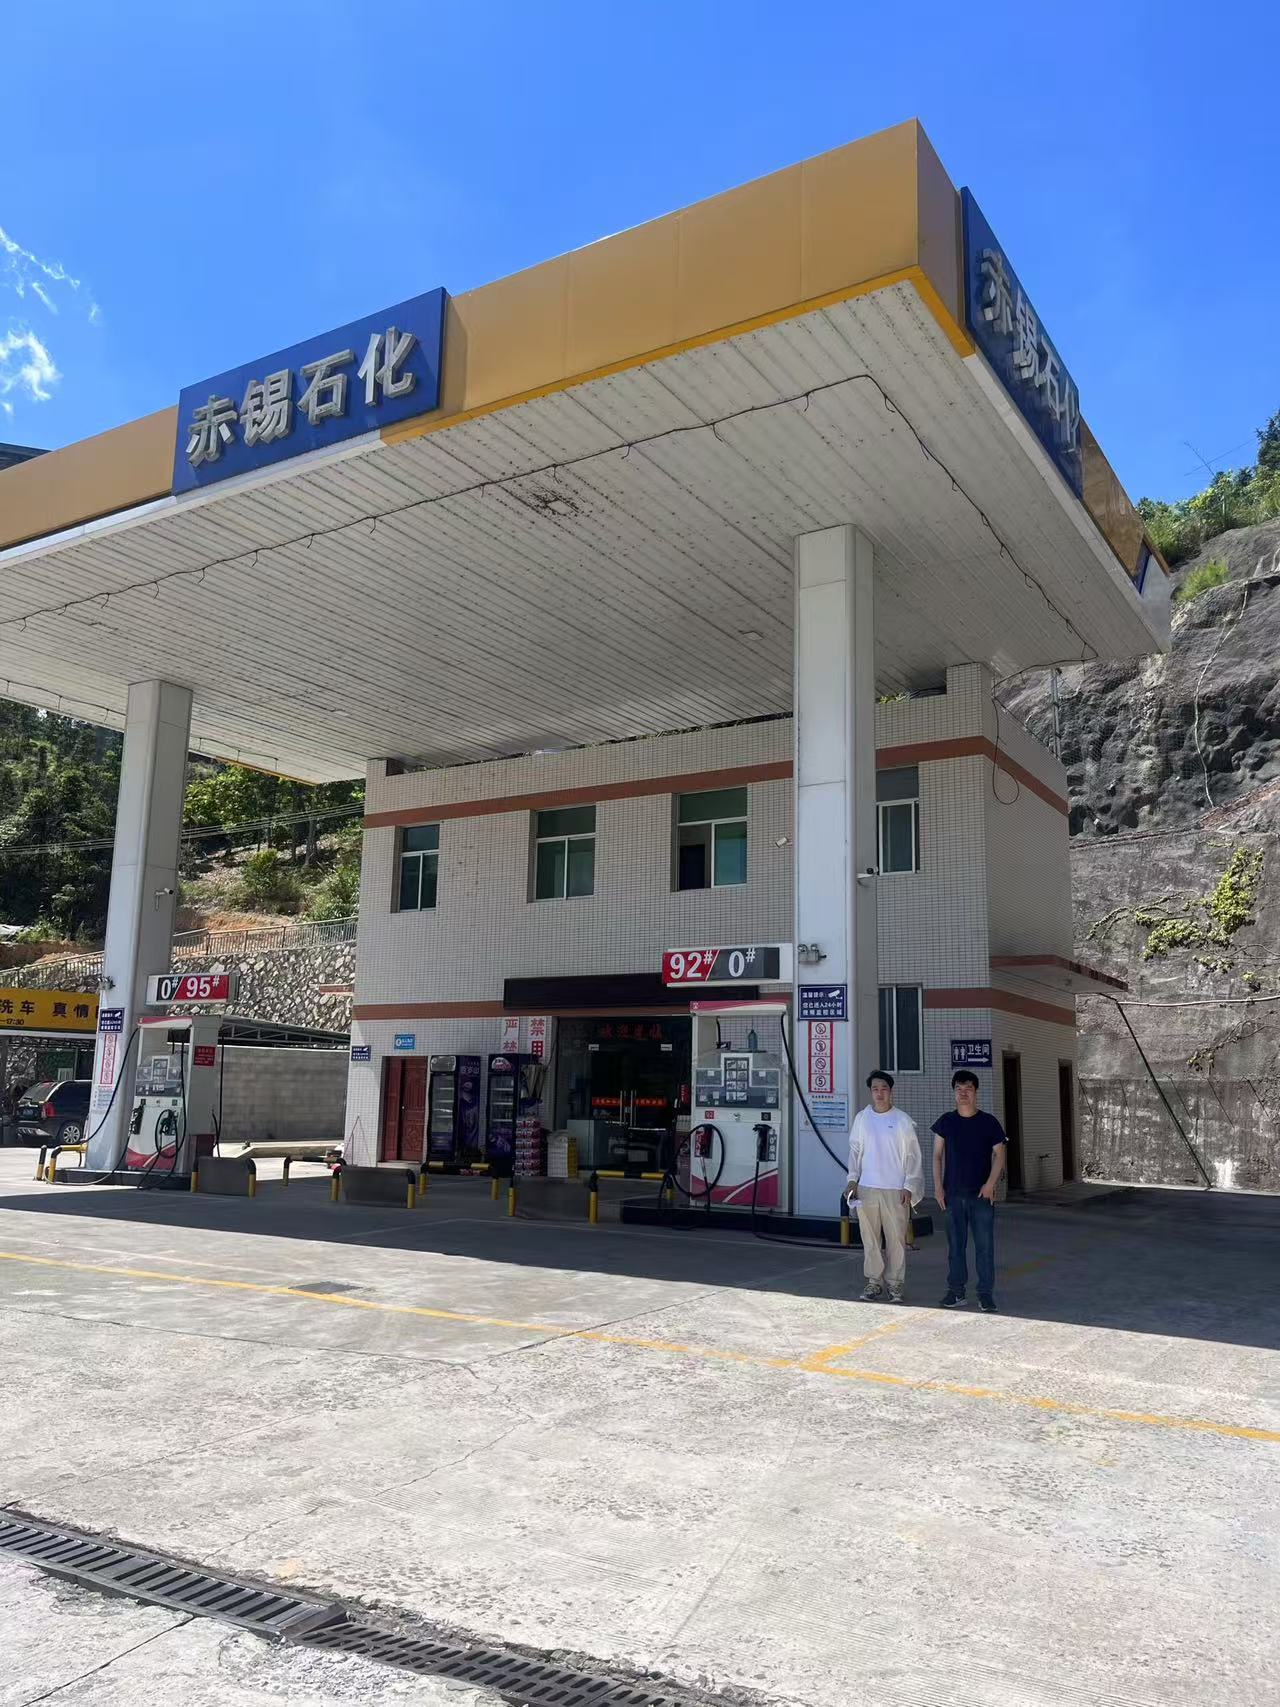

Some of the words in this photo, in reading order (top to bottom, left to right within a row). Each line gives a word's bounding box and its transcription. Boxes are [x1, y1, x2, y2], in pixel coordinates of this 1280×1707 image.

[980, 248, 1081, 454] 赤锡石化
[185, 326, 415, 467] 赤锡石化
[52, 1002, 99, 1018] 真情
[967, 1043, 990, 1056] 卫生间
